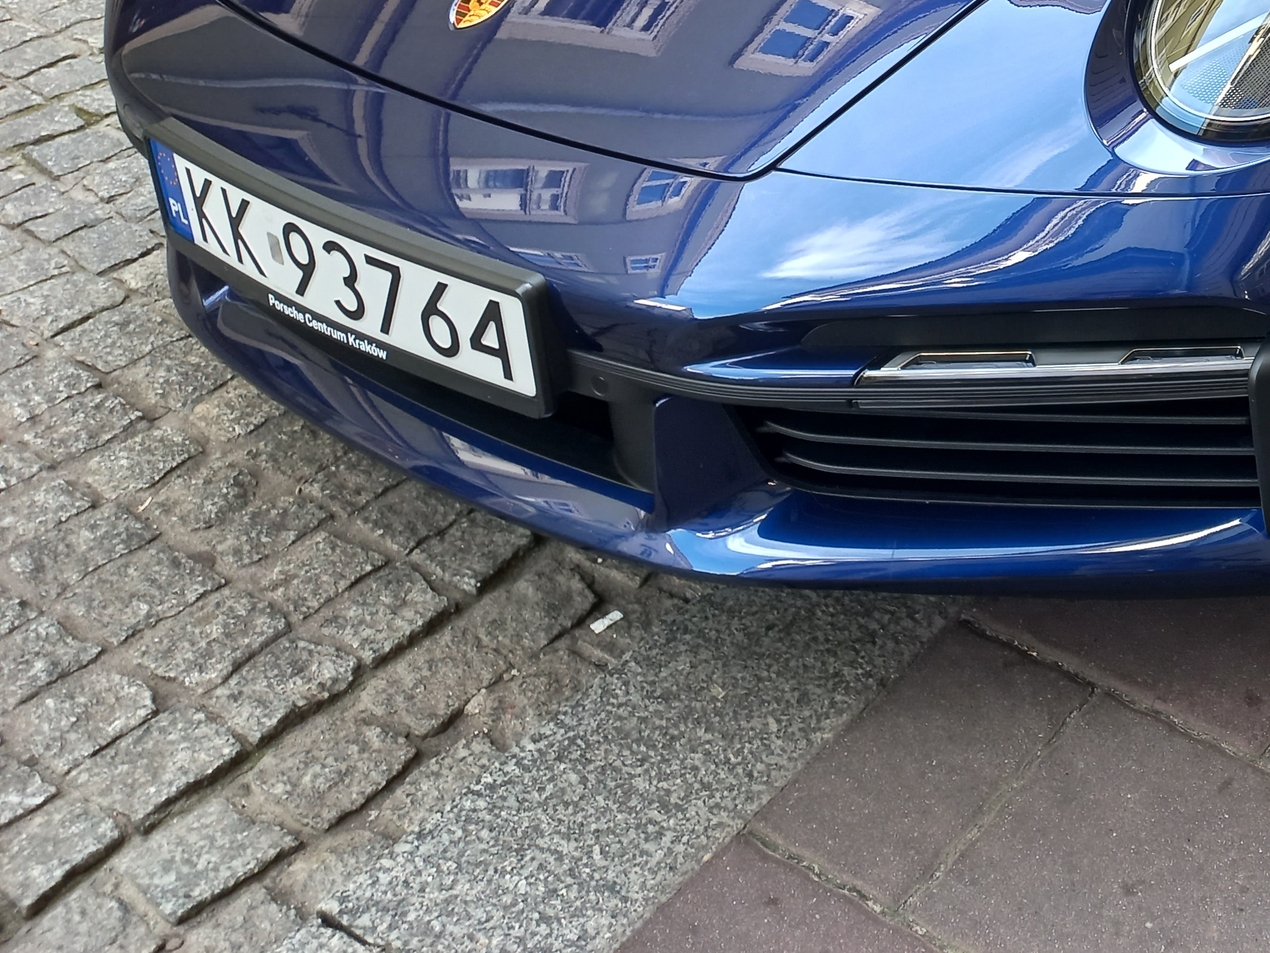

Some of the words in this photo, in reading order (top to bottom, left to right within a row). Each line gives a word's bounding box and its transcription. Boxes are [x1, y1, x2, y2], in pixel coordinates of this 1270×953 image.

[169, 197, 188, 225] PL
[185, 166, 267, 278] KK
[282, 221, 514, 382] 93764
[268, 293, 305, 324] Porsche
[304, 312, 347, 344] Centrum
[347, 332, 388, 360] Kraków
